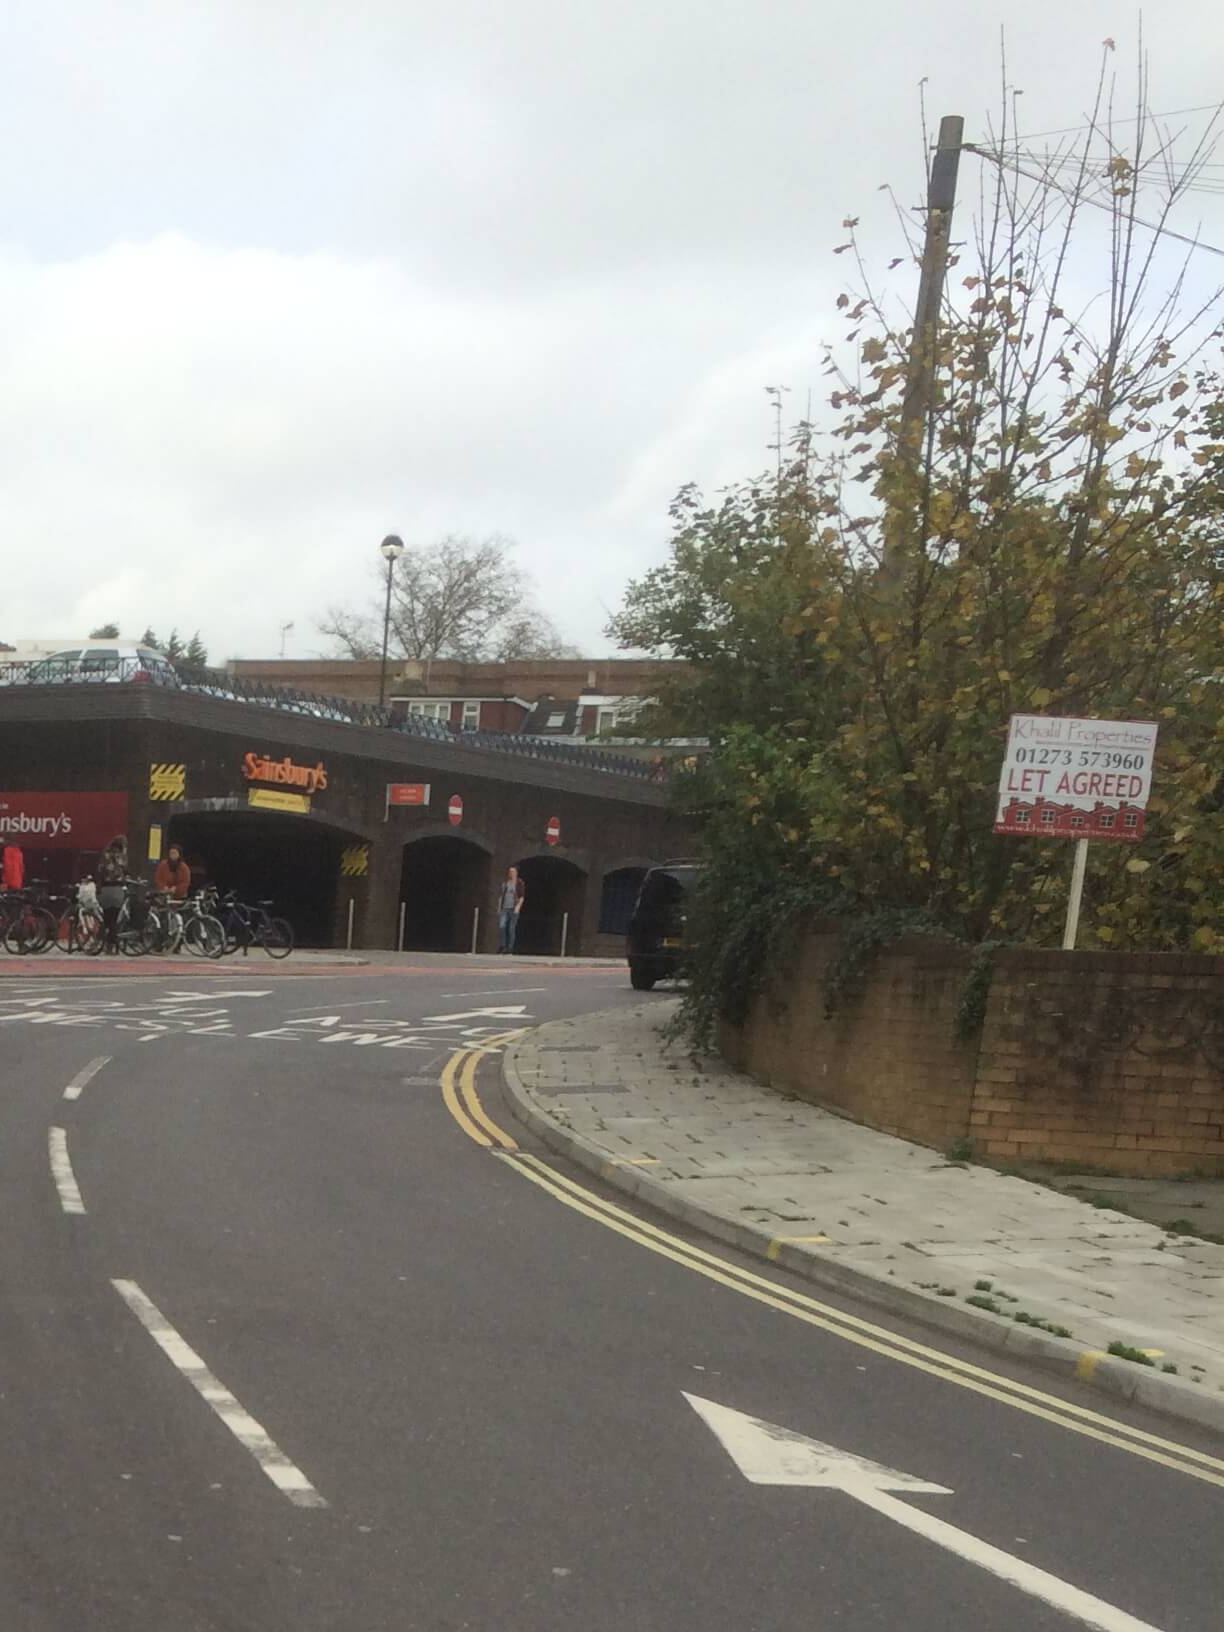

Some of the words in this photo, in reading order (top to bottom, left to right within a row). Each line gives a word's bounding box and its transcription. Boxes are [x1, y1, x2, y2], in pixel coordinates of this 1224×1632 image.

[1068, 721, 1152, 749] Properties
[244, 751, 329, 794] Sainsbury's
[1015, 746, 1073, 767] 01273
[1077, 750, 1145, 771] 573960
[1007, 767, 1052, 793] LET
[1055, 770, 1144, 799] AGREED
